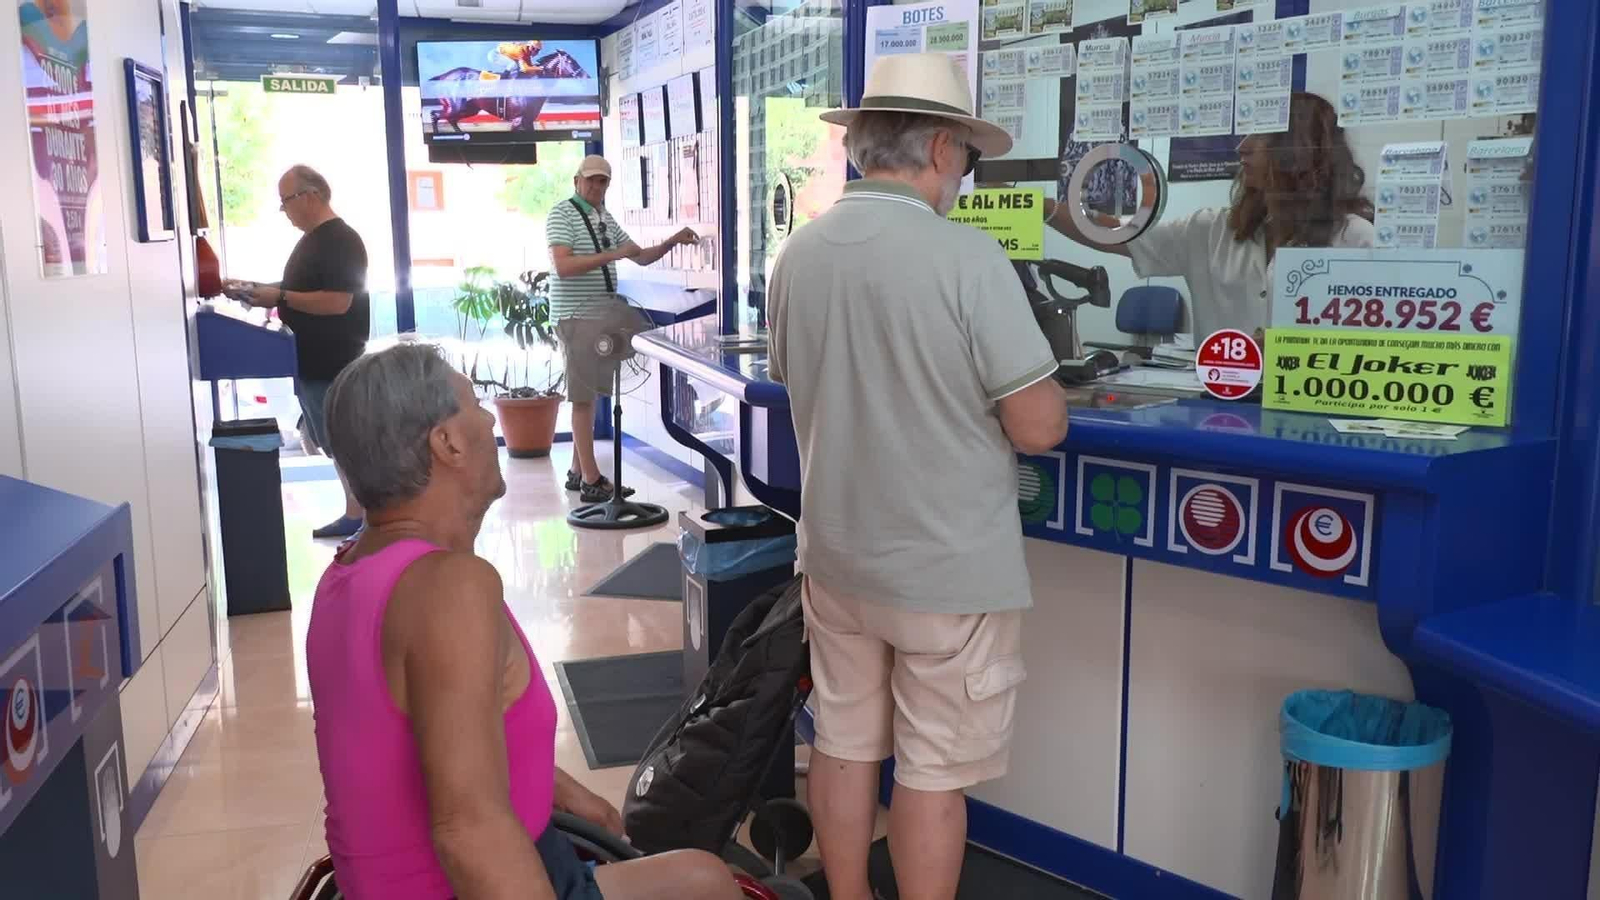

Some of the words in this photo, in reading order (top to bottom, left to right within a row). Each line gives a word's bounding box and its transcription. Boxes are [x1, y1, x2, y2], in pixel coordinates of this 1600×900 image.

[903, 7, 945, 25] BOTES
[880, 39, 917, 49] 17.000.000
[1085, 44, 1111, 52] Murcia
[270, 78, 329, 92] SALIDA
[45, 126, 87, 162] DURANTE
[958, 195, 968, 210] €
[971, 194, 994, 210] AL
[998, 194, 1034, 209] MES
[1327, 284, 1373, 297] HEMOS
[1375, 286, 1457, 300] ENTREGADO
[1294, 296, 1461, 332] 1.428.952
[1470, 302, 1495, 333] €
[1211, 337, 1247, 361] +18
[1307, 353, 1340, 370] El
[1340, 355, 1459, 376] Joker
[1274, 375, 1454, 405] 1.000.000
[1469, 386, 1495, 409] €
[1314, 399, 1364, 409] Participa
[1392, 404, 1418, 412] solo
